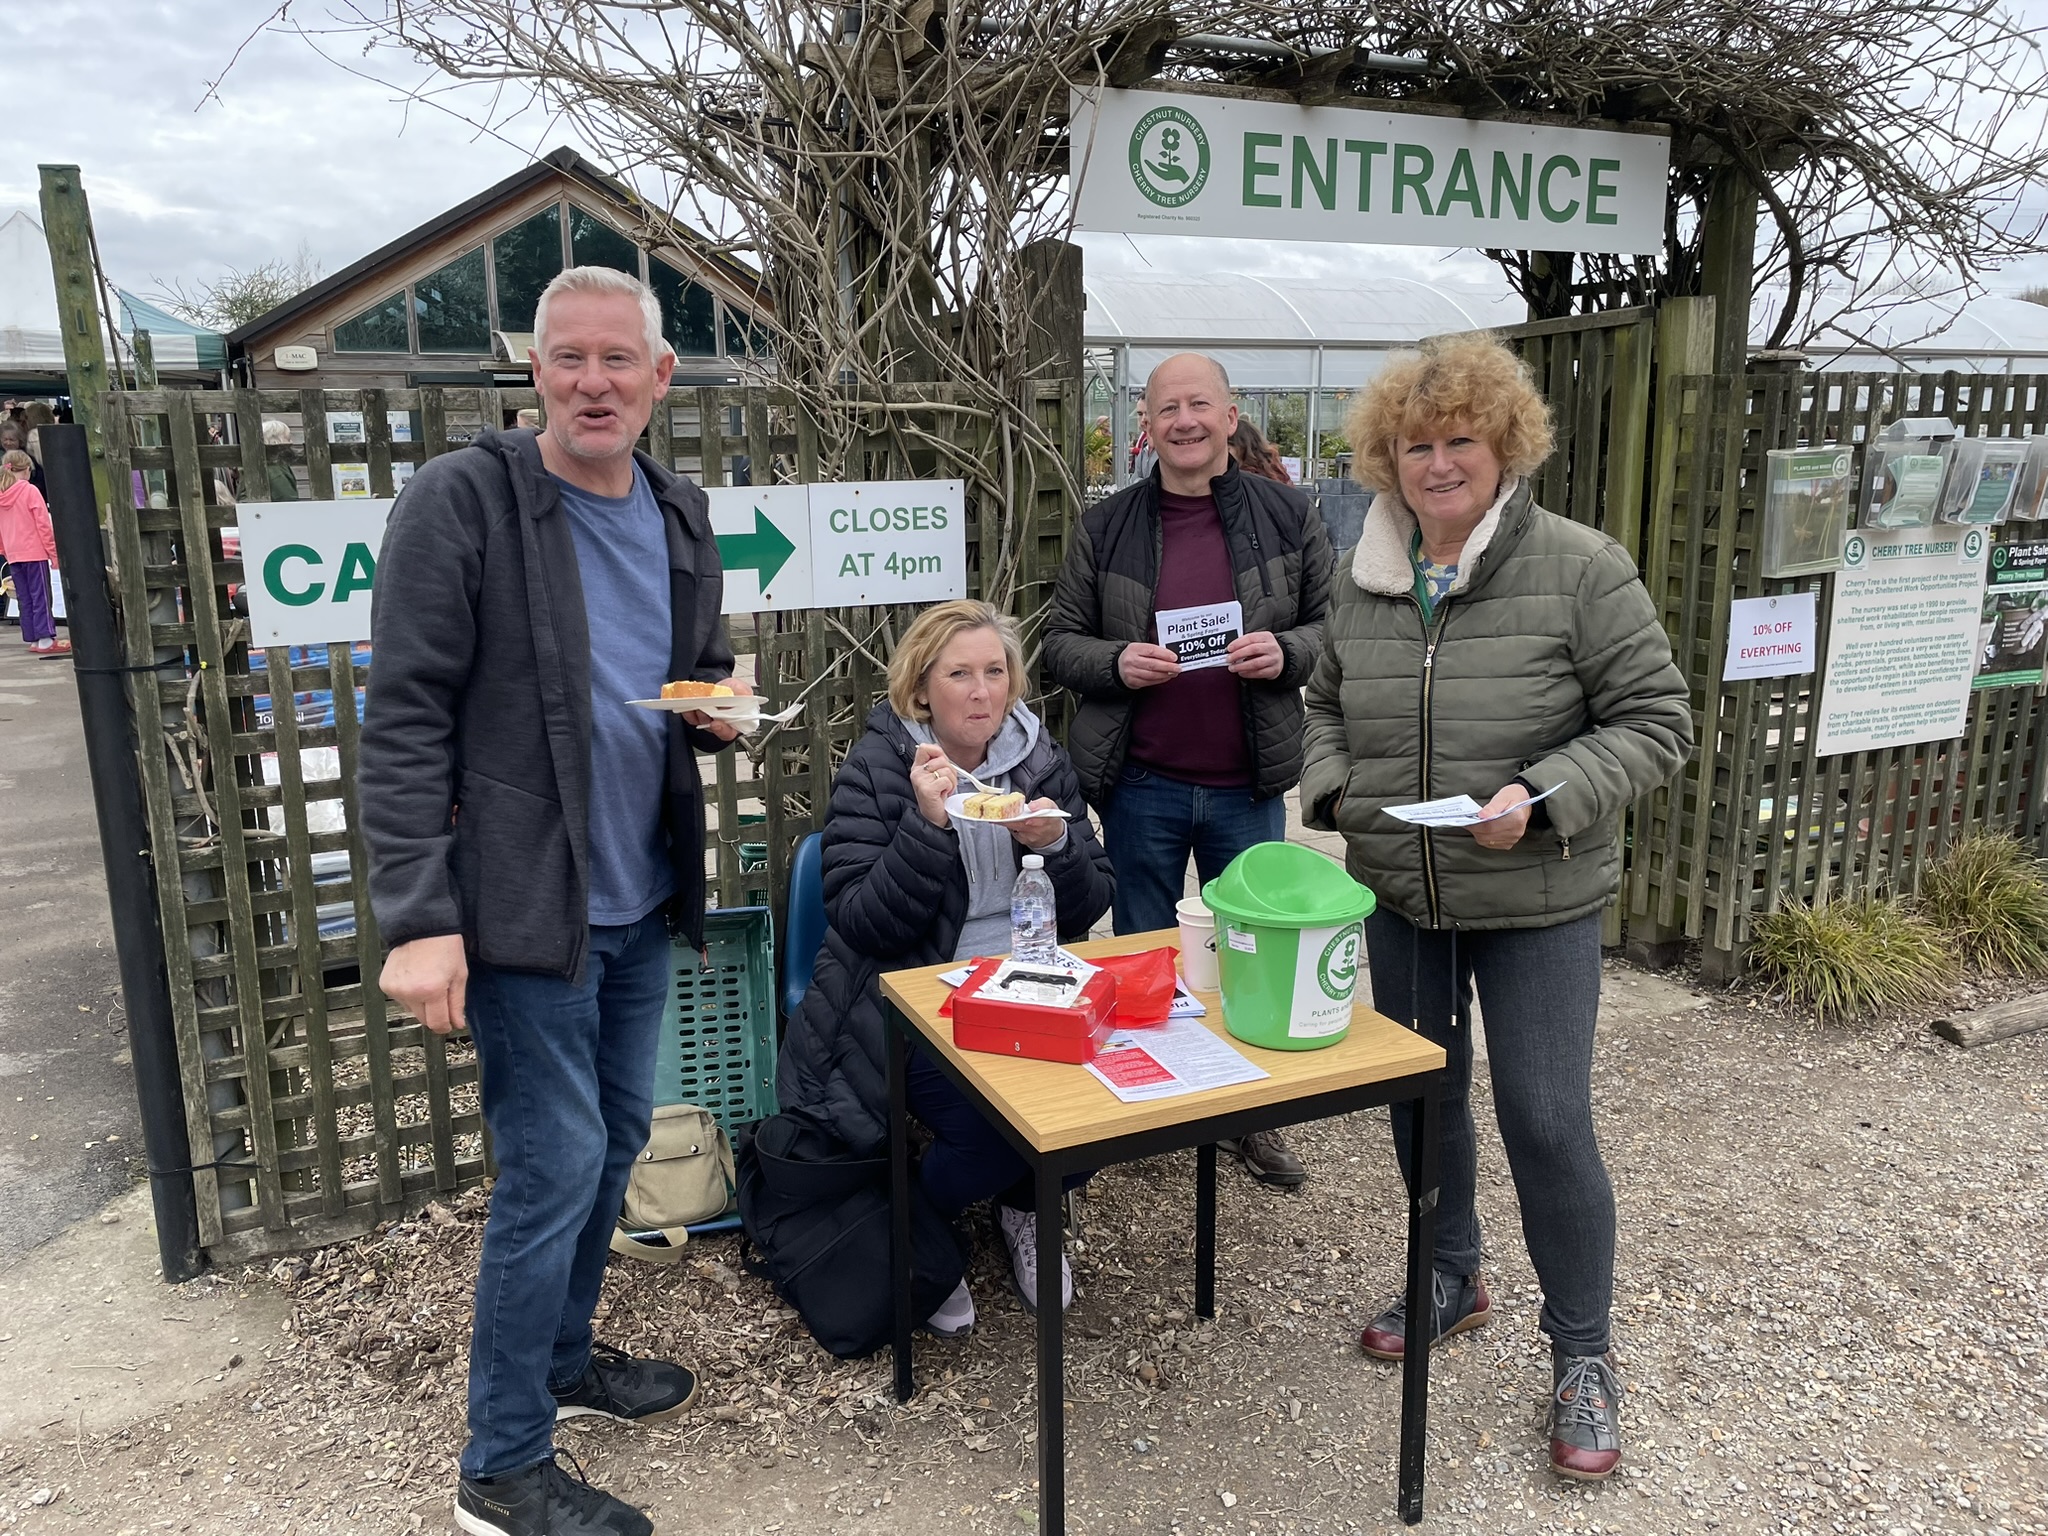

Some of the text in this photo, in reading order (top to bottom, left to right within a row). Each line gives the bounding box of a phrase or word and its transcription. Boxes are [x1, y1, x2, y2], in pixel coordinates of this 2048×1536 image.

[1135, 110, 1206, 146] CHESTNUT NURSERY
[1132, 163, 1207, 204] CHERRY TREE NURSERY
[1242, 131, 1621, 226] ENTRANCE
[830, 506, 948, 534] CLOSES
[1872, 541, 1958, 557] CHERRY TREE NURSERY
[2008, 546, 2032, 558] Plant
[838, 552, 942, 580] AT 4pm
[1846, 579, 1866, 588] Cherry
[1912, 574, 1932, 584] project
[1950, 571, 1977, 581] registered
[1876, 585, 1903, 594] Sheltered
[1920, 581, 1958, 592] Opportunities
[1946, 598, 1967, 607] provide
[1167, 613, 1230, 635] Plant Sale!
[1837, 616, 1865, 625] sheltered
[1882, 611, 1919, 621] rehabilitation
[1929, 608, 1948, 618] people
[1949, 606, 1978, 616] recovering
[1753, 622, 1792, 636] 10% OFF
[1884, 621, 1900, 630] living
[1179, 634, 1226, 654] 10% Off
[1879, 638, 1903, 647] hundred
[1904, 635, 1934, 644] volunteers
[1948, 632, 1965, 640] attend
[1180, 652, 1209, 662] Everything
[1740, 642, 1802, 659] EVERYTHING
[1838, 651, 1864, 661] regularly
[1873, 649, 1885, 657] help
[1886, 646, 1910, 656] produce
[1943, 641, 1961, 650] variety
[1834, 668, 1858, 677] conifers
[1841, 675, 1874, 686] opportunity
[1883, 672, 1901, 681] regain
[1844, 684, 1867, 694] develop
[1868, 680, 1901, 690] self-esteem
[1945, 674, 1962, 682] caring
[1828, 711, 1849, 721] Cherry
[1899, 702, 1926, 711] existence
[1935, 697, 1961, 706] donations
[1842, 717, 1871, 727] charitable
[1924, 706, 1961, 717] organisations
[259, 712, 305, 727] Topil
[1899, 720, 1916, 728] whom
[1916, 718, 1929, 727] help
[1938, 714, 1958, 724] regular
[1871, 731, 1896, 741] standing
[1324, 926, 1354, 957] CHESTNUT
[1320, 973, 1337, 996] CHERRY
[1312, 1006, 1340, 1017] PLANTS
